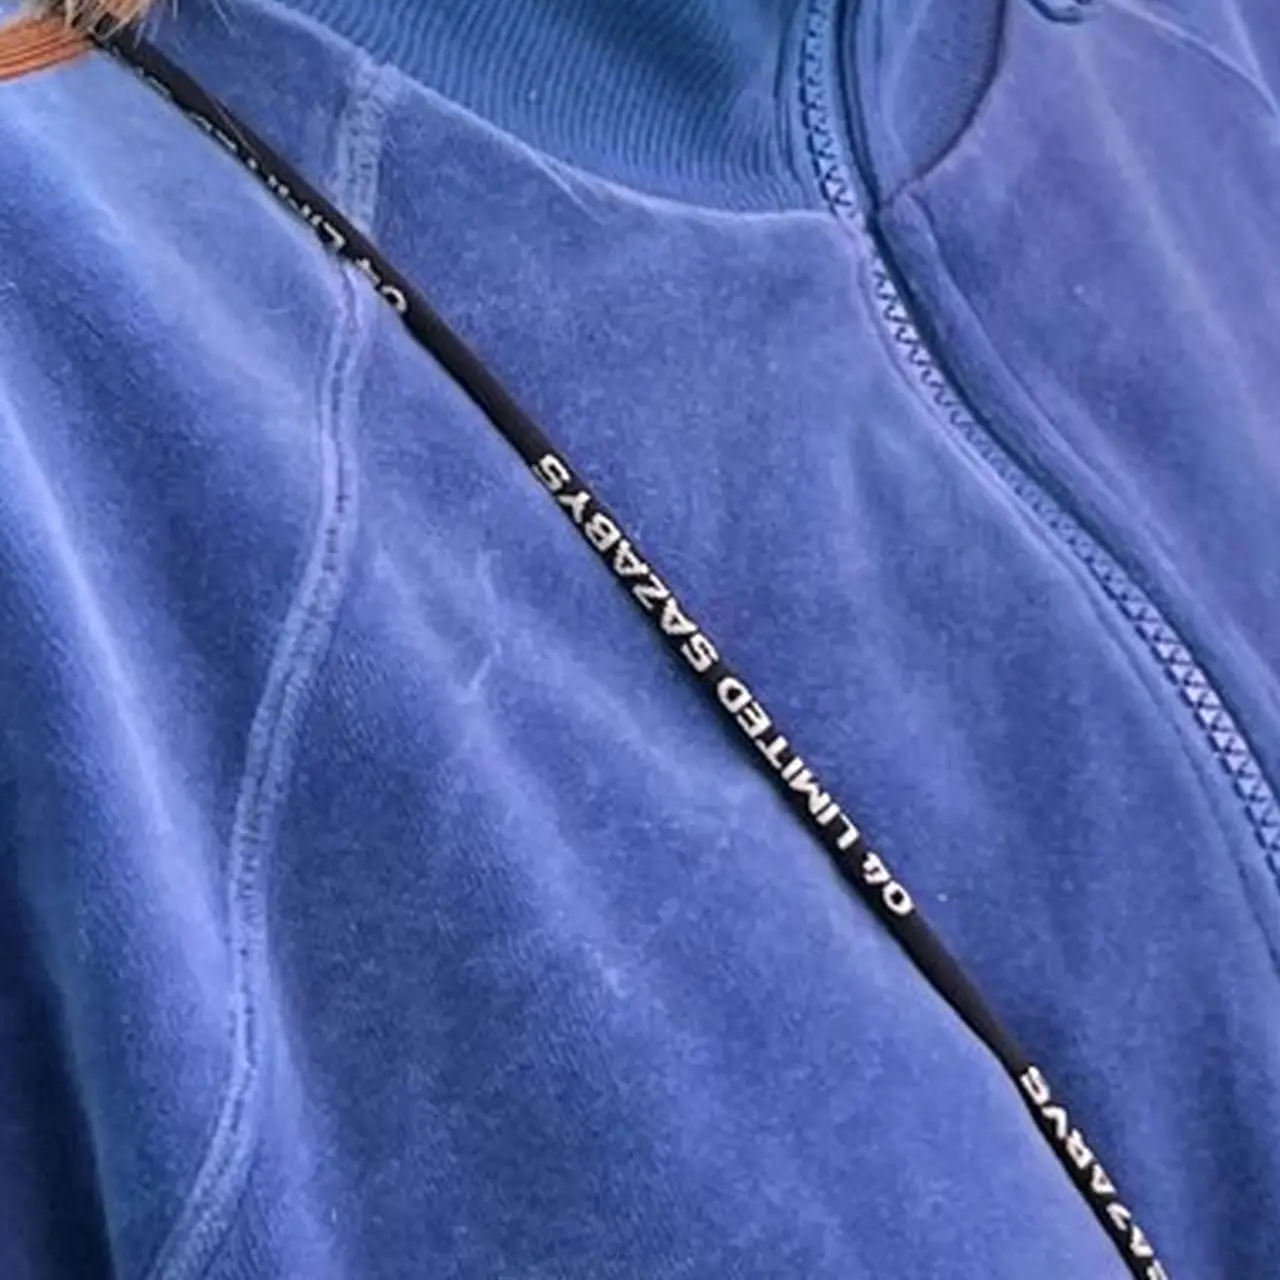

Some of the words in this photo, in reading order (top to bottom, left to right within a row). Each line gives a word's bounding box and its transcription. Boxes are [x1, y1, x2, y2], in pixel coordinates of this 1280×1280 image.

[535, 453, 720, 674] SAZABYS
[717, 676, 861, 851] LIMITED
[862, 851, 914, 917] 04
